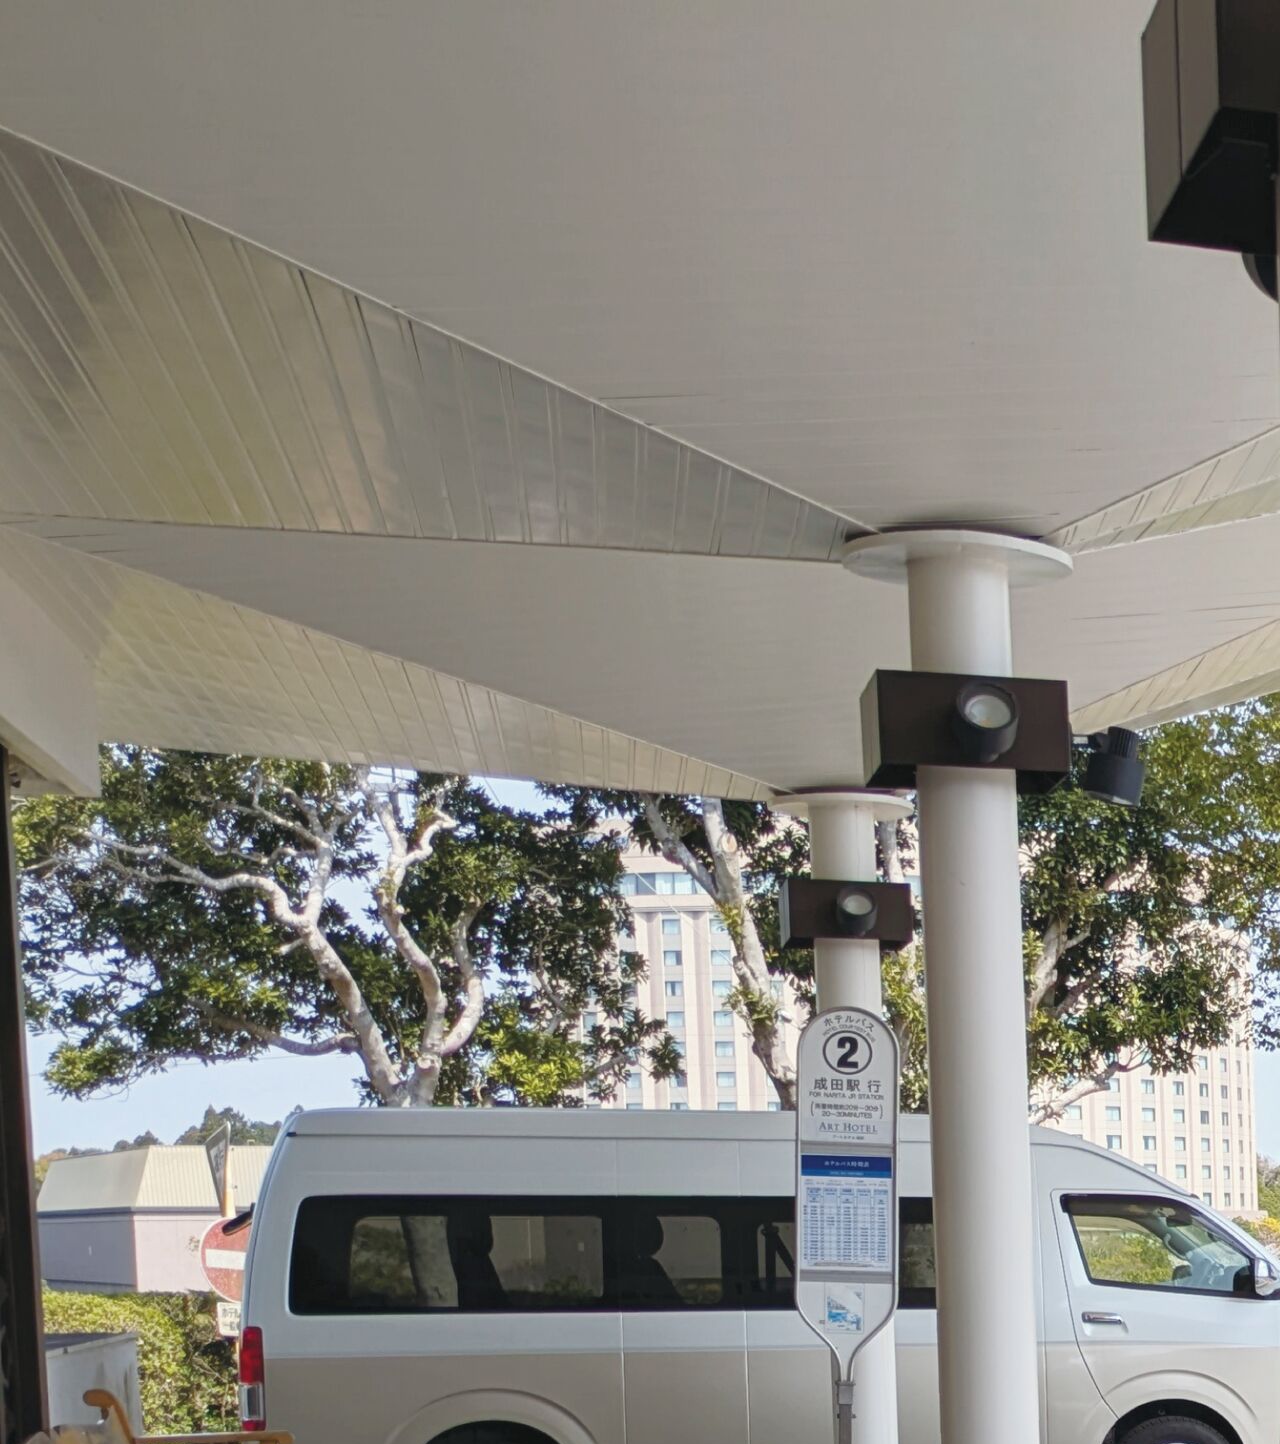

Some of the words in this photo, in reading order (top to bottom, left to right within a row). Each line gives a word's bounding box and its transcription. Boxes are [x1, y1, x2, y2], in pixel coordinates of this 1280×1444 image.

[824, 1015, 875, 1031] ホテルバス
[837, 1037, 858, 1069] 2
[819, 1122, 839, 1131] ART
[844, 1123, 878, 1132] HOTEL
